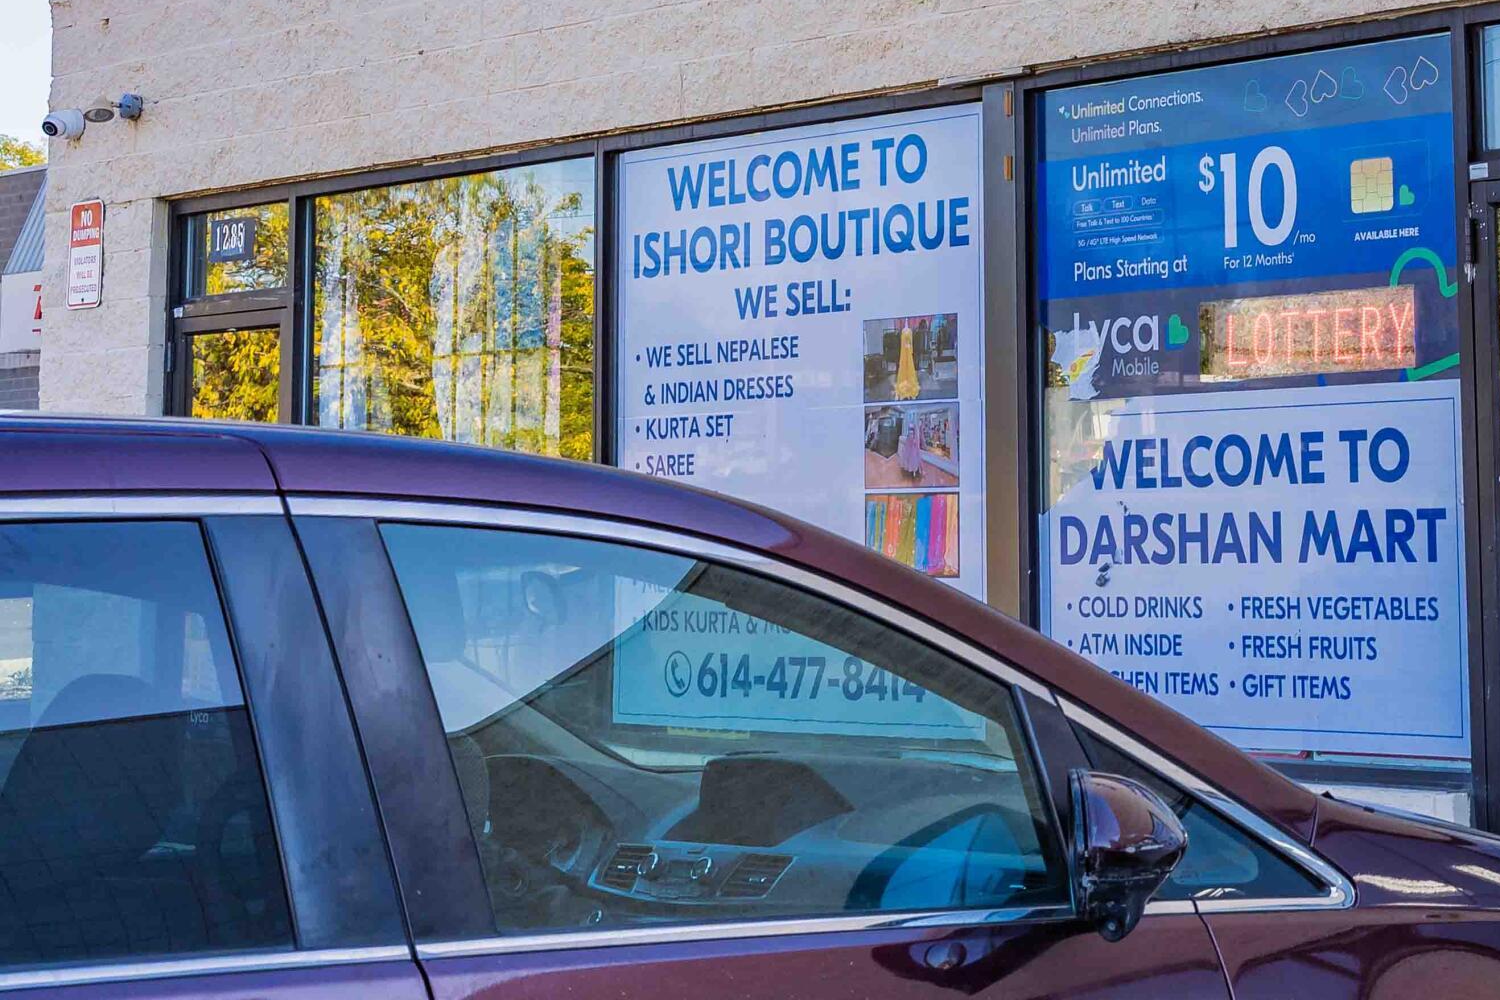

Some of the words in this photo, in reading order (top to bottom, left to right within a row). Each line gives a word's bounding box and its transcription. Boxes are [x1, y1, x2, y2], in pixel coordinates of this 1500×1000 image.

[1072, 98, 1124, 120] Unlimited
[1129, 90, 1204, 112] Connections.
[1072, 123, 1125, 144] Unlimited
[1129, 119, 1162, 136] Plans.
[667, 142, 860, 212] WELCOME
[872, 133, 927, 187] TO
[1072, 155, 1166, 192] Unlimited
[80, 211, 93, 227] NO
[73, 227, 99, 242] DUMPING
[633, 222, 751, 280] ISHORI
[765, 196, 970, 266] BOUTIQUE
[1354, 228, 1398, 242] AVAILABLE
[1399, 227, 1419, 238] HERE
[1074, 261, 1112, 282] Plans
[1116, 257, 1168, 279] Starting
[1173, 254, 1187, 274] at
[1223, 256, 1240, 270] For
[1243, 254, 1252, 268] 12
[735, 283, 778, 321] WE
[786, 279, 851, 318] SELL:
[1225, 302, 1412, 368] LOTTERY
[646, 345, 672, 369] WE
[677, 342, 712, 367] SELL
[717, 335, 799, 364] NEPALESE
[1112, 356, 1159, 377] Mobile
[644, 384, 655, 406] &
[661, 380, 718, 405] INDIAN
[724, 374, 794, 401] DRESSES
[646, 416, 701, 440] KURTA
[706, 414, 734, 438] SET
[646, 453, 695, 477] SAREE
[1090, 431, 1325, 490] WELCOME
[1339, 427, 1410, 484] TO
[1059, 511, 1282, 566] DARSHAN
[1298, 508, 1447, 564] MART
[1079, 596, 1129, 618] COLD
[1135, 596, 1203, 619] DRINKS
[1241, 596, 1301, 620] FRESH
[1307, 596, 1439, 621] VEGETABLES
[643, 610, 679, 633] KIDS
[684, 610, 740, 634] KURTA
[1079, 633, 1119, 655] ATM
[1124, 634, 1183, 657] INSIDE
[1242, 635, 1302, 659] FRESH
[1309, 636, 1378, 661] FRUITS
[1165, 672, 1219, 696] ITEMS
[1242, 674, 1286, 698] GIFT
[1292, 675, 1351, 700] ITEMS
